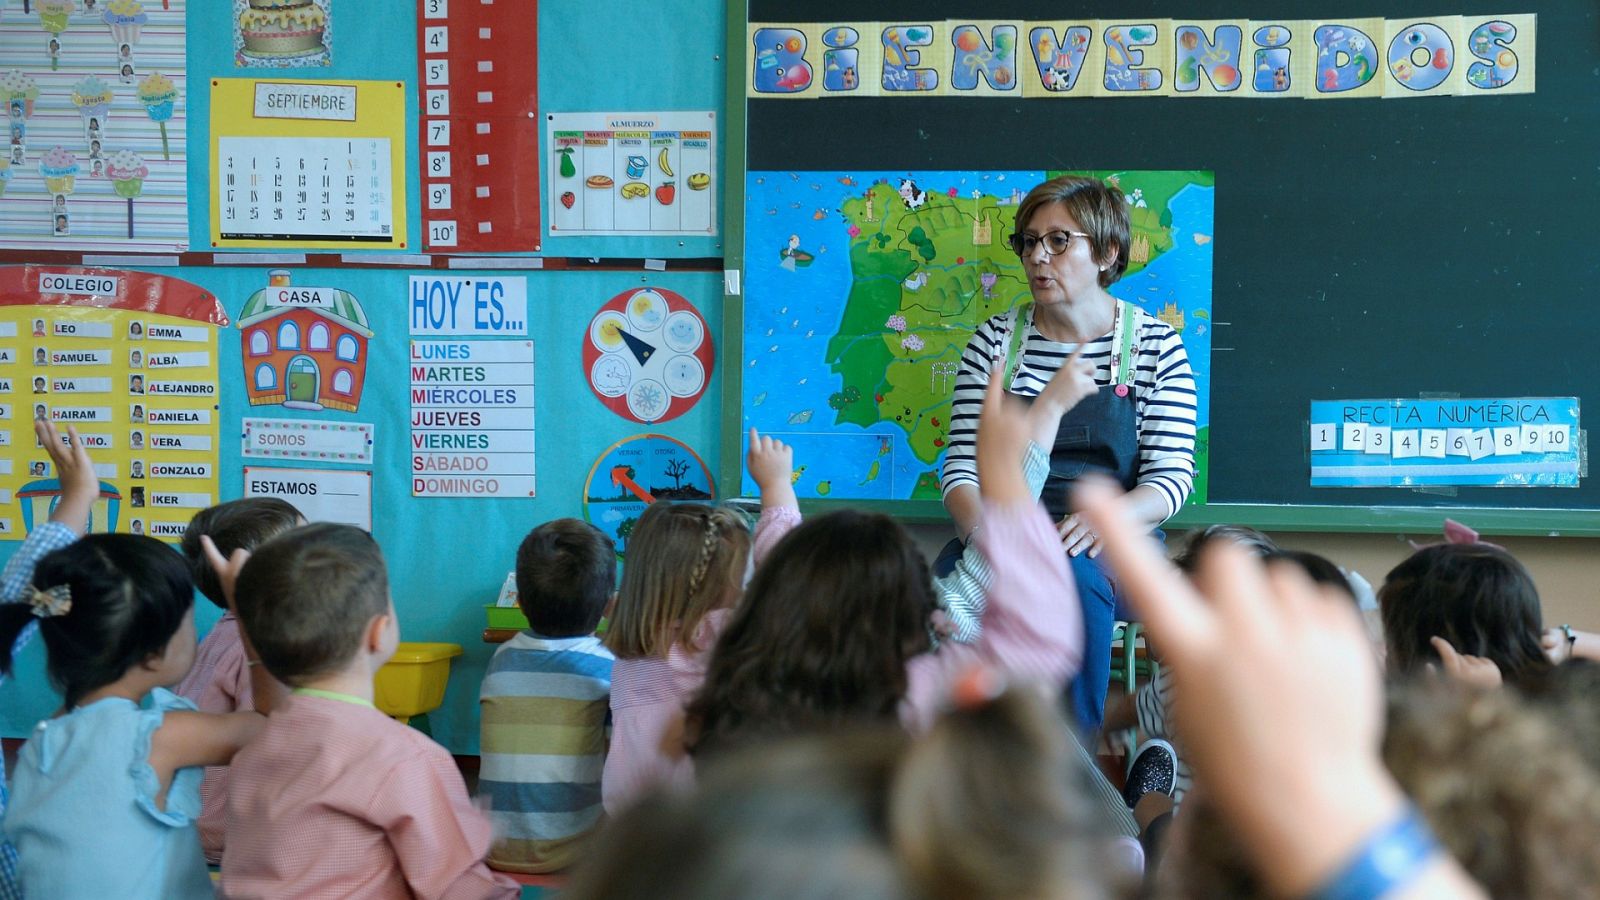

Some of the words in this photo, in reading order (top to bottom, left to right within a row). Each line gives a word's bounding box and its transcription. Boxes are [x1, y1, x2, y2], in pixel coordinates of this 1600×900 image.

[267, 93, 346, 110] SEPTIEMBRE
[228, 174, 234, 186] 10
[274, 174, 282, 187] 12
[298, 174, 306, 188] 13
[346, 176, 354, 188] 15
[228, 189, 235, 202] 17
[274, 190, 282, 203] 19
[297, 191, 306, 204] 20
[322, 191, 330, 204] 21
[250, 207, 258, 220] 25
[274, 208, 282, 220] 26
[297, 208, 306, 220] 27
[42, 277, 114, 292] COLEGIO
[278, 290, 322, 304] CASA
[412, 280, 462, 330] HOY
[474, 281, 523, 330] ES...
[55, 324, 76, 334] LEO
[148, 328, 182, 338] EMMA
[53, 352, 98, 363] SAMUEL
[412, 344, 470, 360] LUNES
[150, 356, 179, 366] ALBA
[412, 366, 486, 382] MARTES
[54, 382, 76, 391] EVA
[150, 384, 214, 394] ALEJANDRO
[412, 386, 517, 404] MIÉRCOLES
[52, 410, 96, 420] HAIRAM
[150, 413, 200, 422] DANIELA
[412, 411, 482, 426] JUEVES
[1343, 406, 1422, 424] RECTA
[152, 438, 182, 448] VERA
[258, 433, 306, 447] SOMOS
[413, 434, 489, 449] VIERNES
[1320, 430, 1326, 442] 1
[1352, 430, 1361, 442] 2
[1374, 433, 1382, 446] 3
[1402, 436, 1411, 449] 4
[1430, 436, 1439, 450] 5
[1454, 436, 1464, 450] 6
[1474, 436, 1483, 450] 7
[1504, 434, 1512, 446] 8
[1530, 432, 1538, 444] 9
[1548, 431, 1564, 444] 10
[414, 453, 488, 472] SÁBADO
[152, 466, 206, 476] GONZALO
[252, 480, 317, 496] ESTAMOS
[414, 478, 499, 494] DOMINGO
[152, 495, 178, 505] IKER
